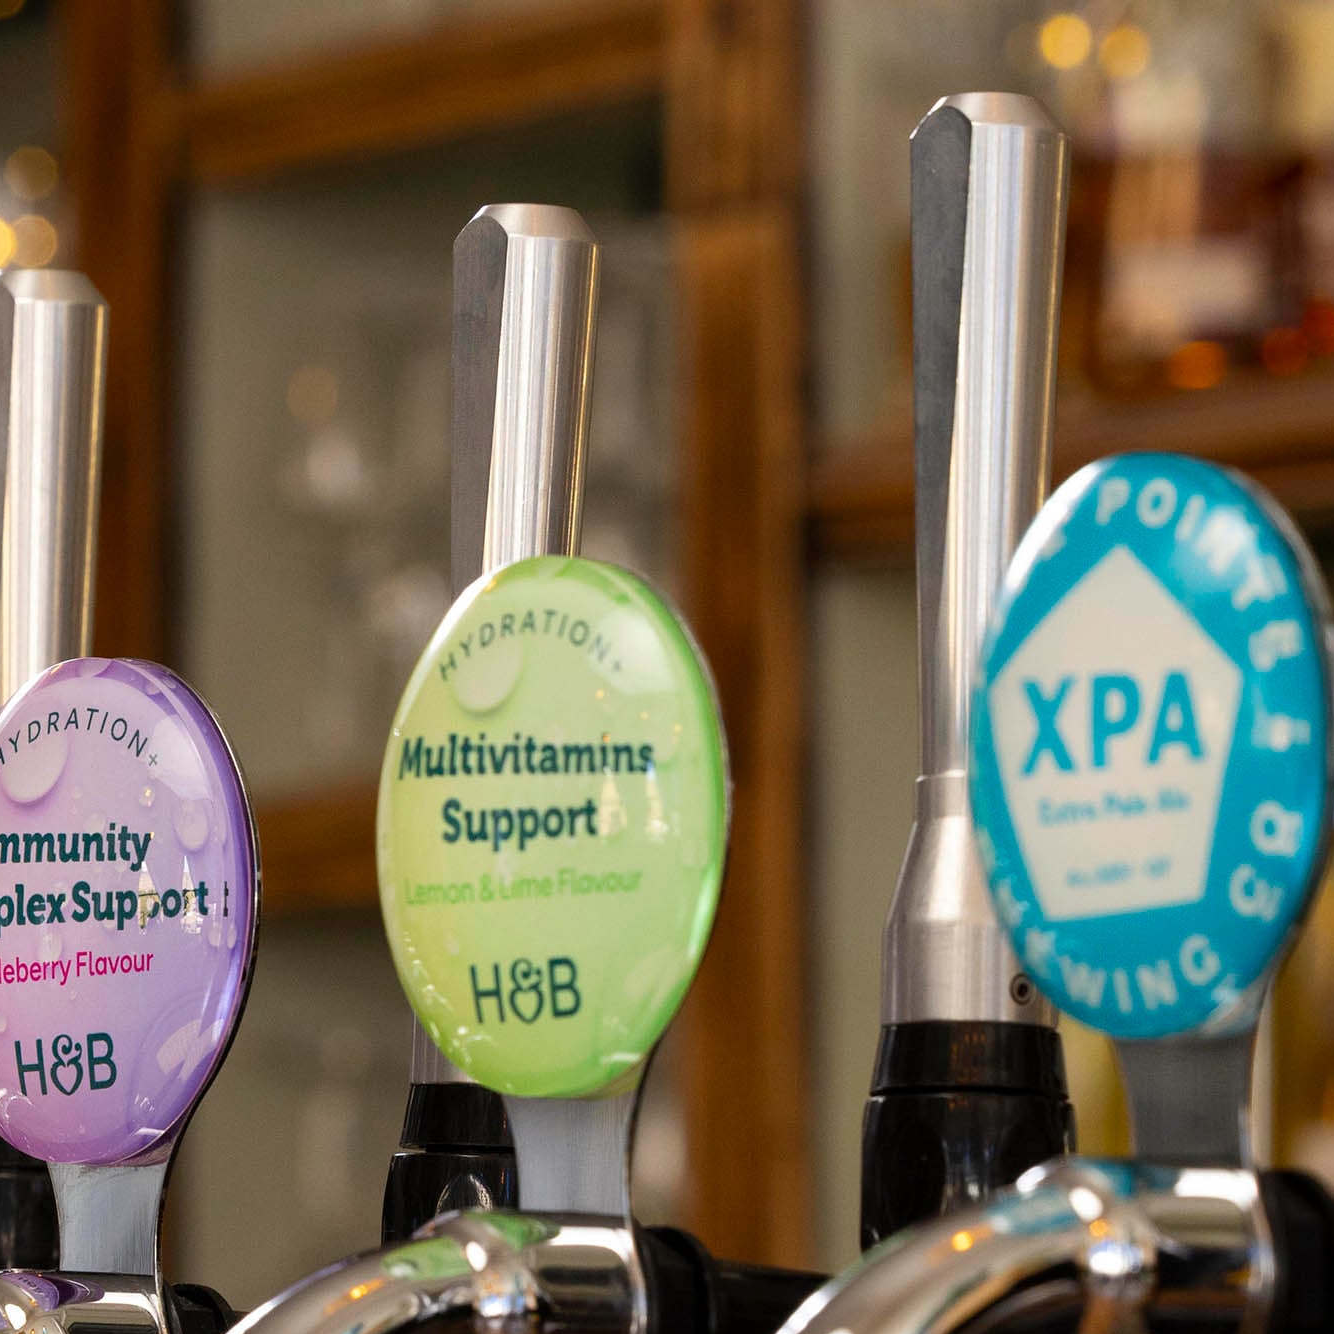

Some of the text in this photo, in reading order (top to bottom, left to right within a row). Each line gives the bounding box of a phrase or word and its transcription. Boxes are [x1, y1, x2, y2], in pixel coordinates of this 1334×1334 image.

[1019, 667, 1207, 776] XPA
[398, 731, 657, 782] Multivitamins
[441, 797, 599, 853] Support
[404, 875, 476, 905] Lemon
[479, 872, 495, 902] &
[556, 866, 644, 896] Flavour
[975, 825, 1224, 1017] WING
[75, 949, 155, 979] Flavour
[469, 955, 583, 1025] H&B
[14, 1031, 118, 1097] H&B
